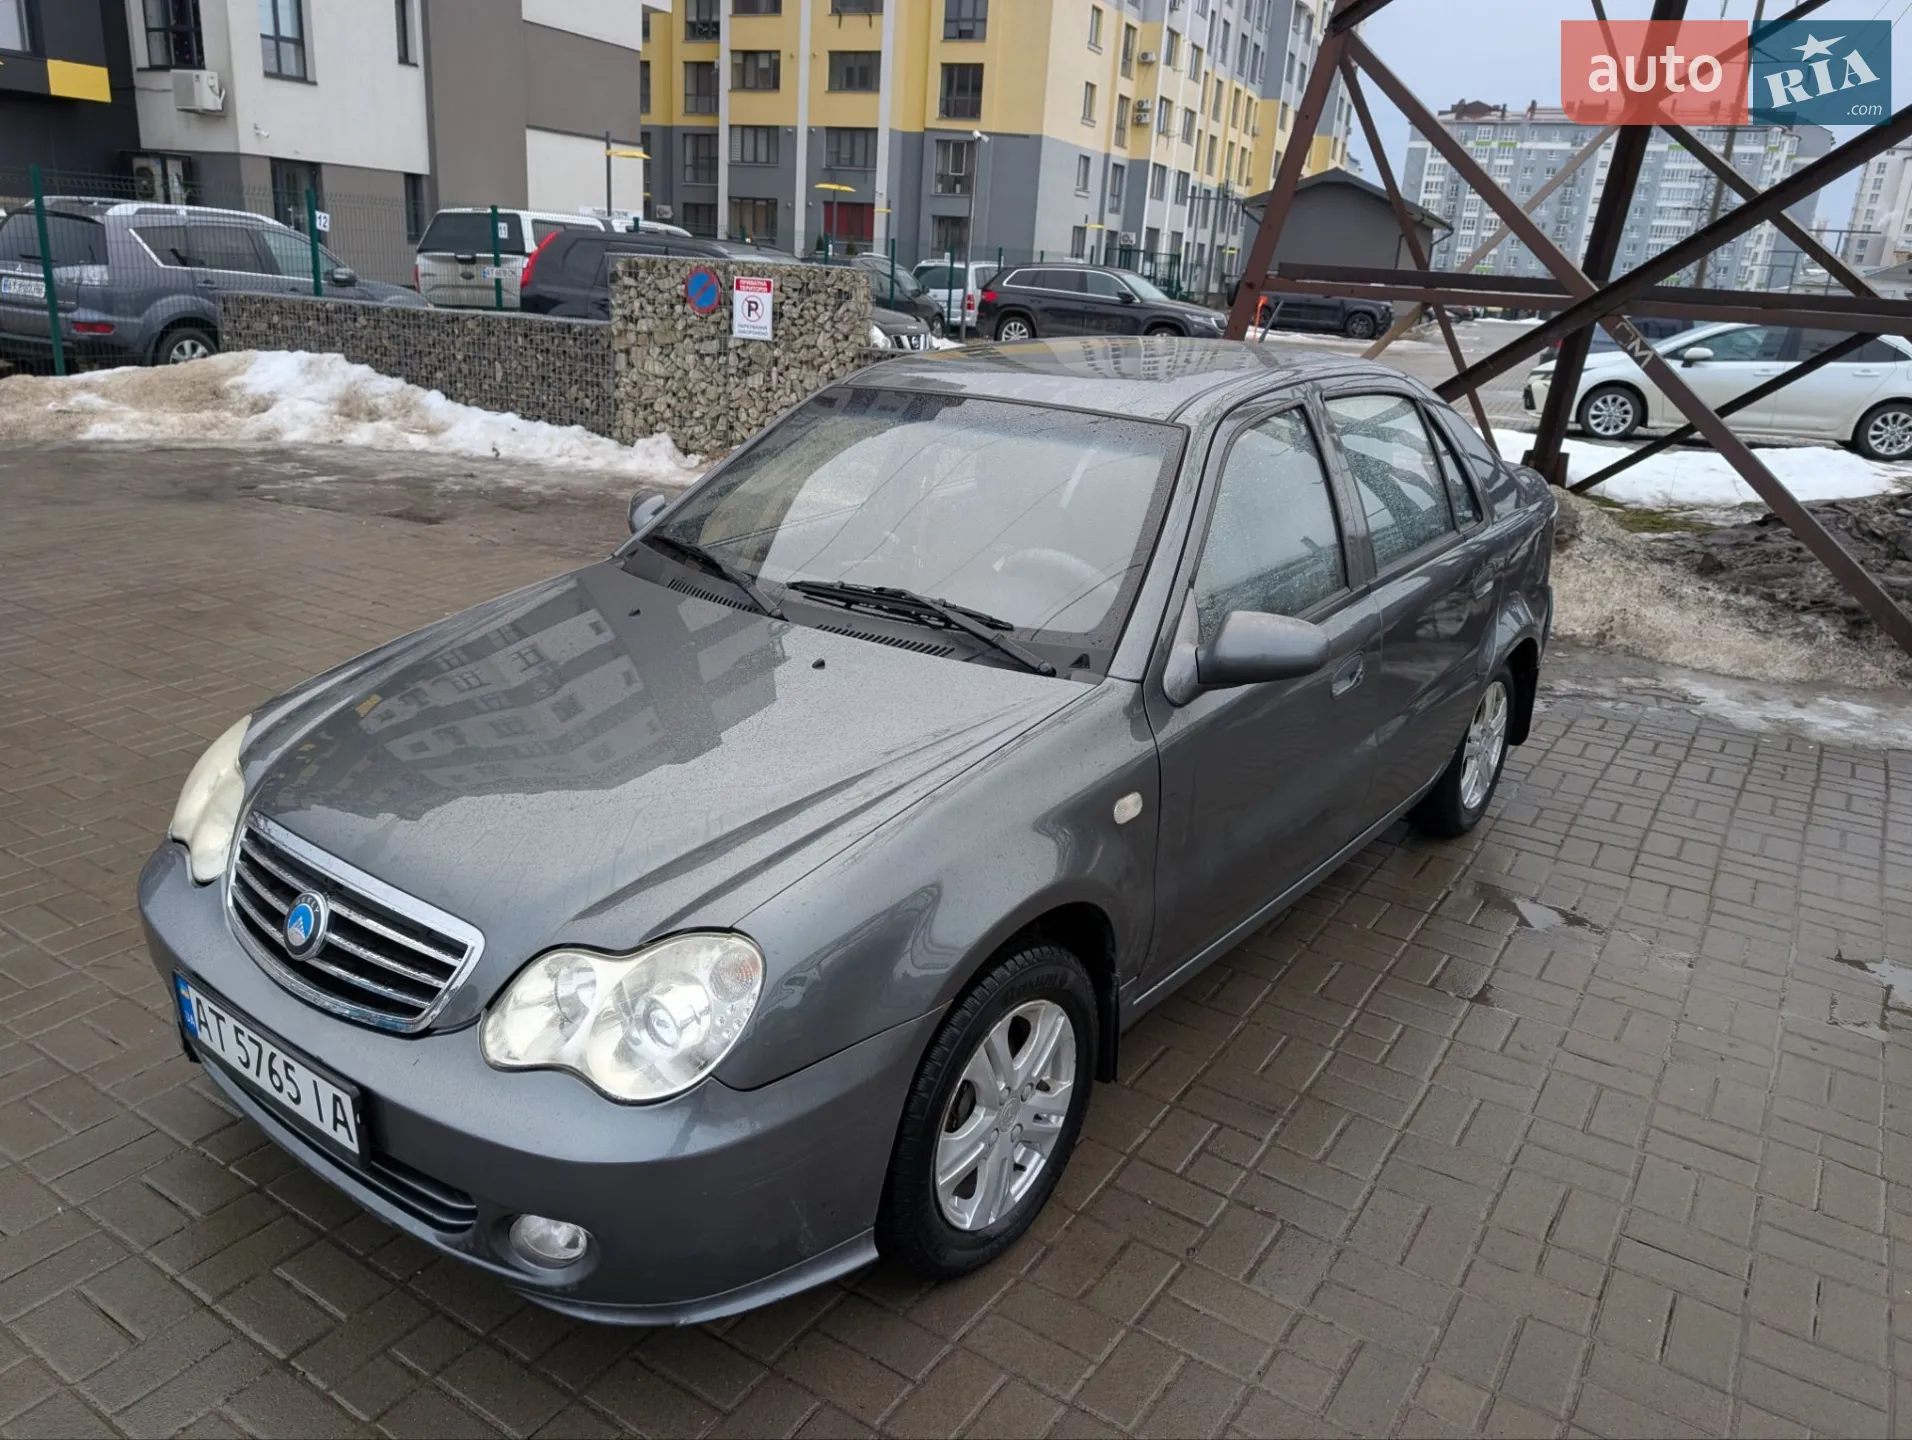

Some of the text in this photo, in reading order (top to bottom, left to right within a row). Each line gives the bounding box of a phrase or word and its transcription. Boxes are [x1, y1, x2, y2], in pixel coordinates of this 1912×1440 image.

[318, 215, 328, 229] 12
[195, 996, 355, 1144] AT 5765 IA
